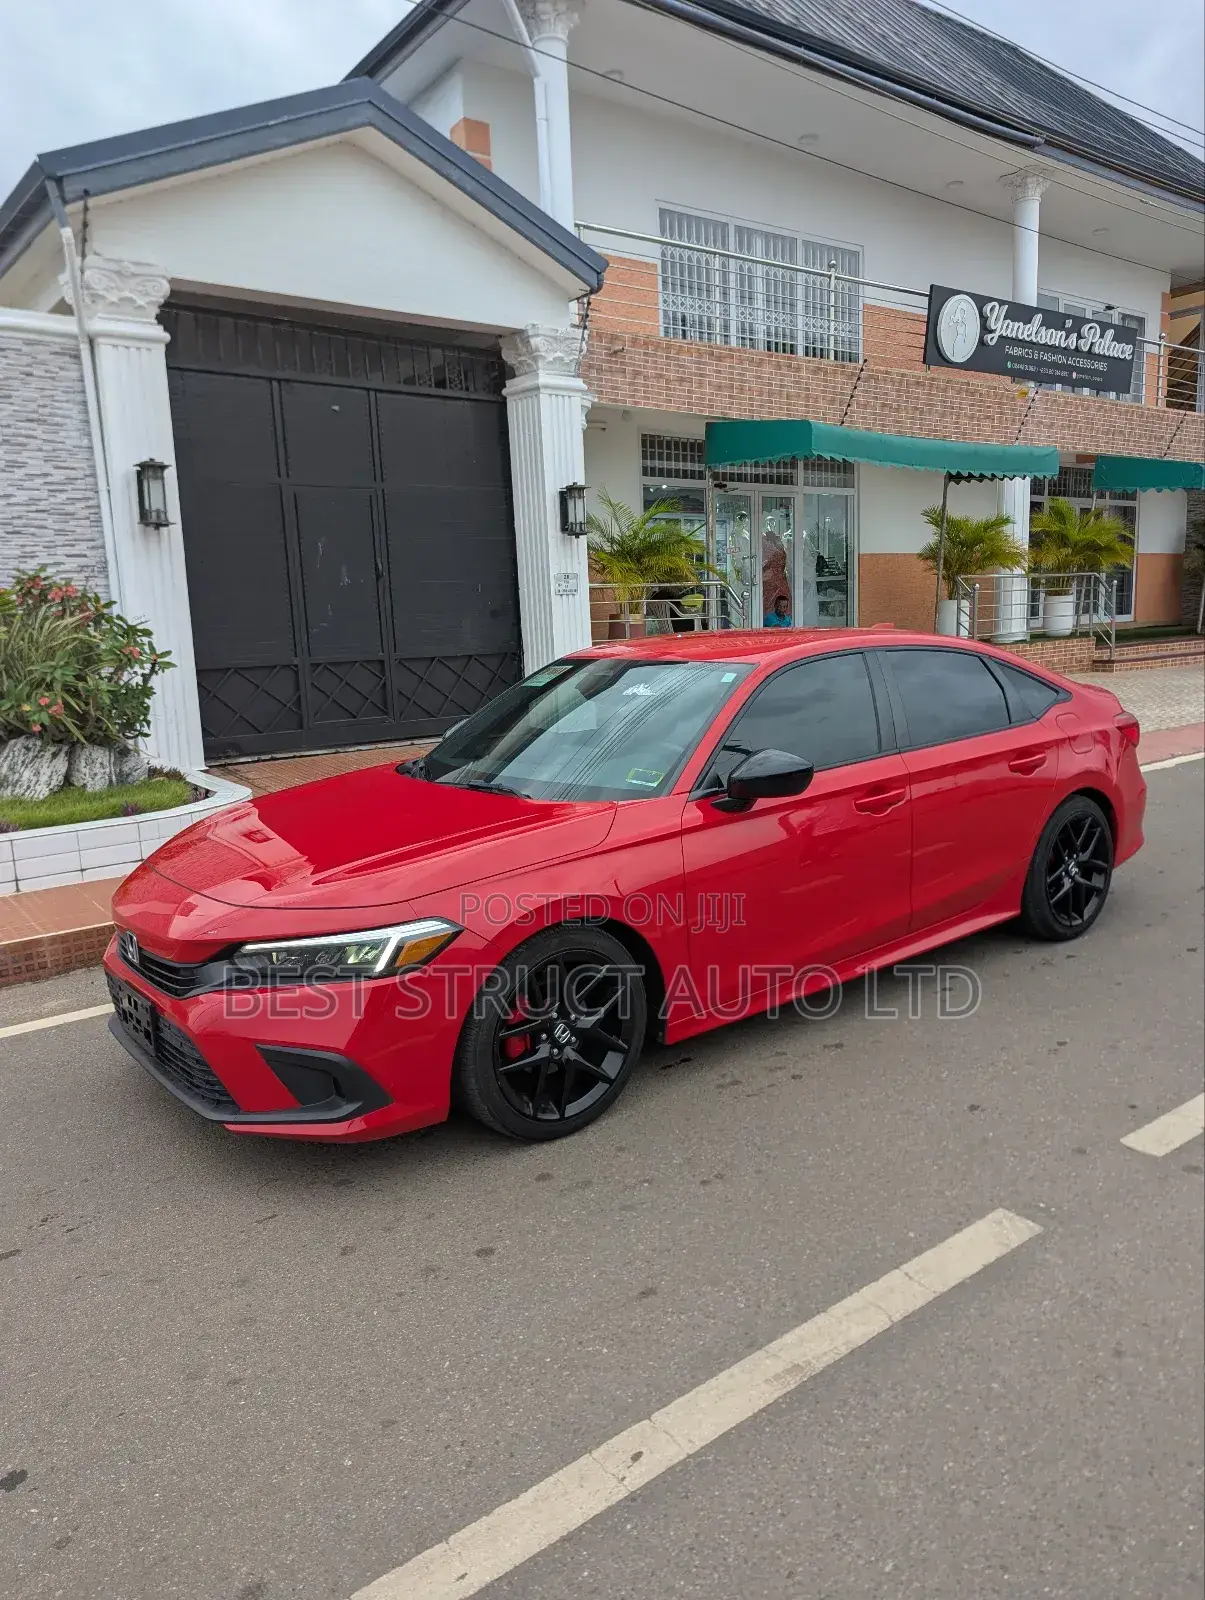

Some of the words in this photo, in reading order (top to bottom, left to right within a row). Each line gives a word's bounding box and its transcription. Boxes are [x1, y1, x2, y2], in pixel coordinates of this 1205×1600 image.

[982, 301, 1077, 350] Yanelson's
[1077, 322, 1134, 360] Palace
[1004, 345, 1033, 359] FABRICS
[1033, 351, 1039, 360] &
[1040, 352, 1067, 364] FASHION
[1067, 358, 1108, 371] ACCESSORIES
